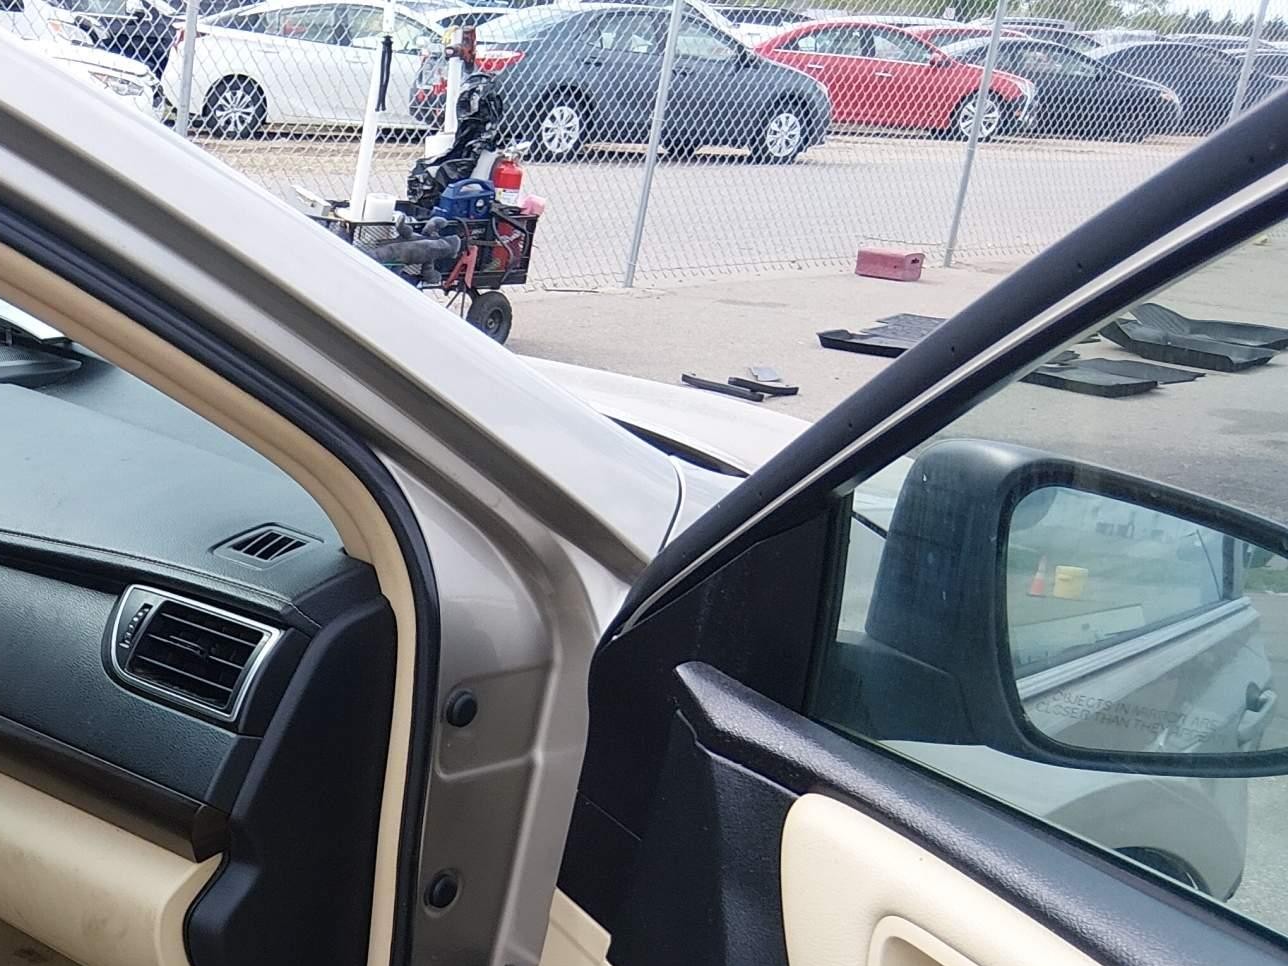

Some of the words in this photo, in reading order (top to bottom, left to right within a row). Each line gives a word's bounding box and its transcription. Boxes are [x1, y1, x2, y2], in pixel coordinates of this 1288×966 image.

[1052, 689, 1113, 711] OBJECTS
[1114, 701, 1130, 715] IN
[1094, 711, 1130, 728] THAN
